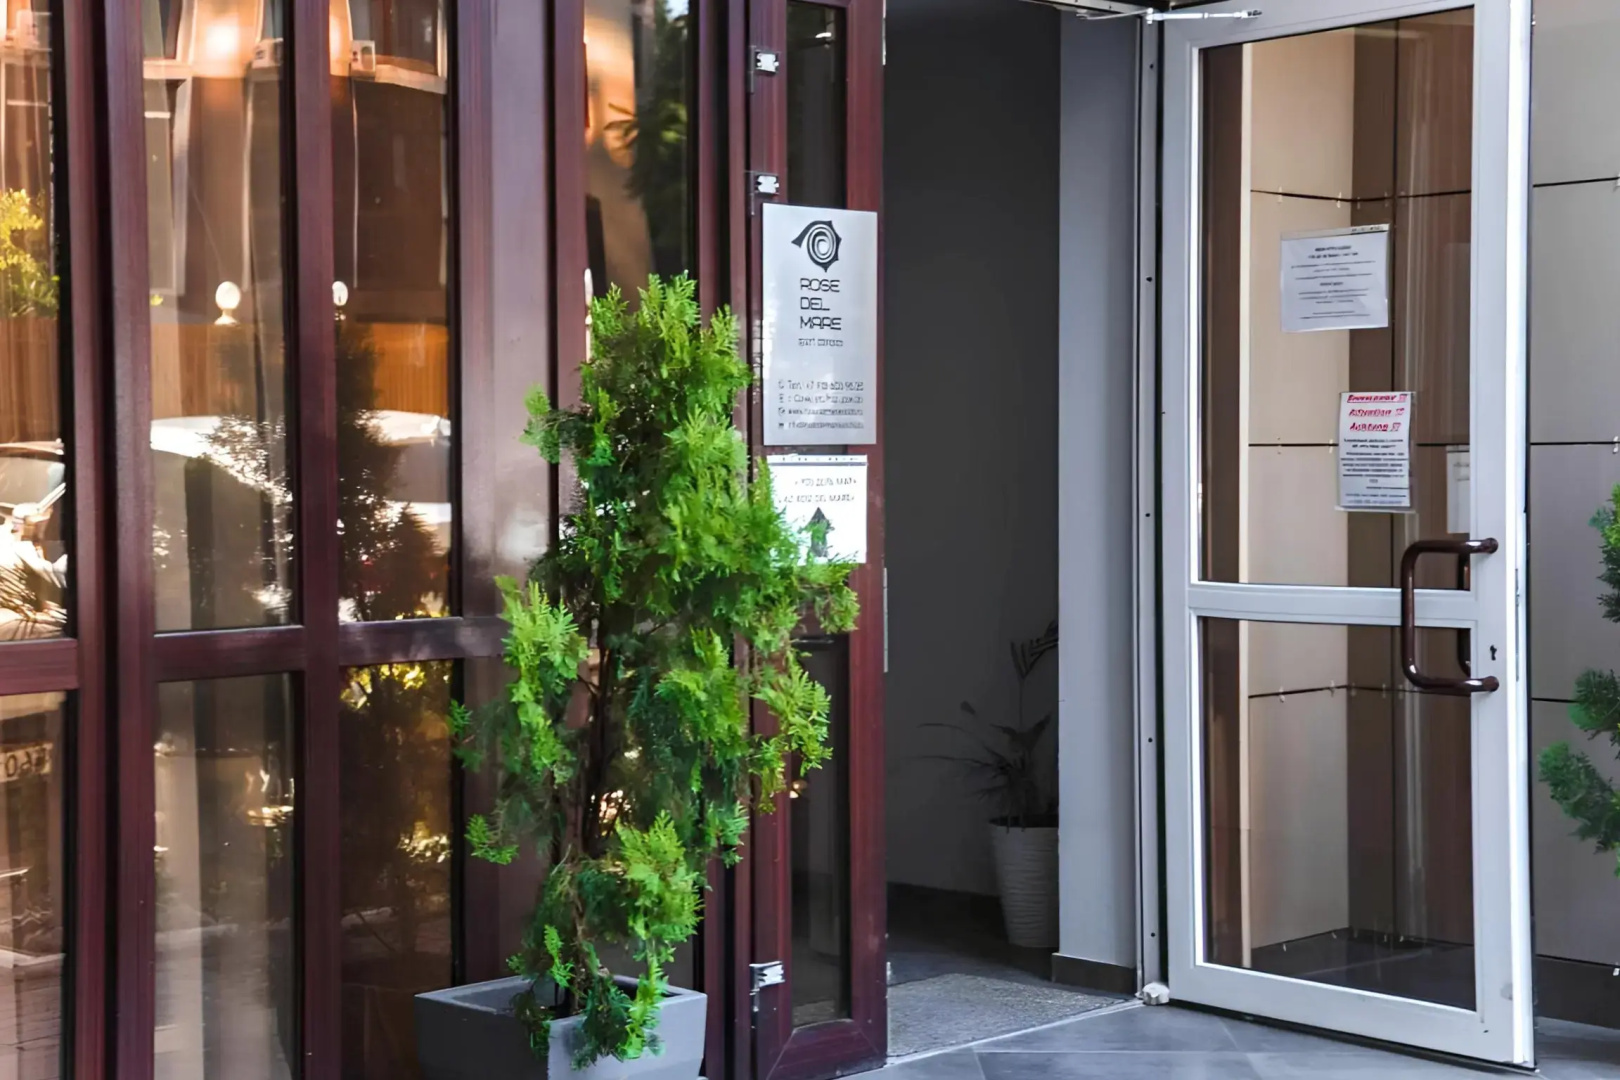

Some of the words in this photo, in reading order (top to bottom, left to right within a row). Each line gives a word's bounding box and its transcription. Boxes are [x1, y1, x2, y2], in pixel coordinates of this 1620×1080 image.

[800, 278, 840, 292] ROSE
[800, 297, 830, 311] DEL
[800, 316, 841, 330] MARE
